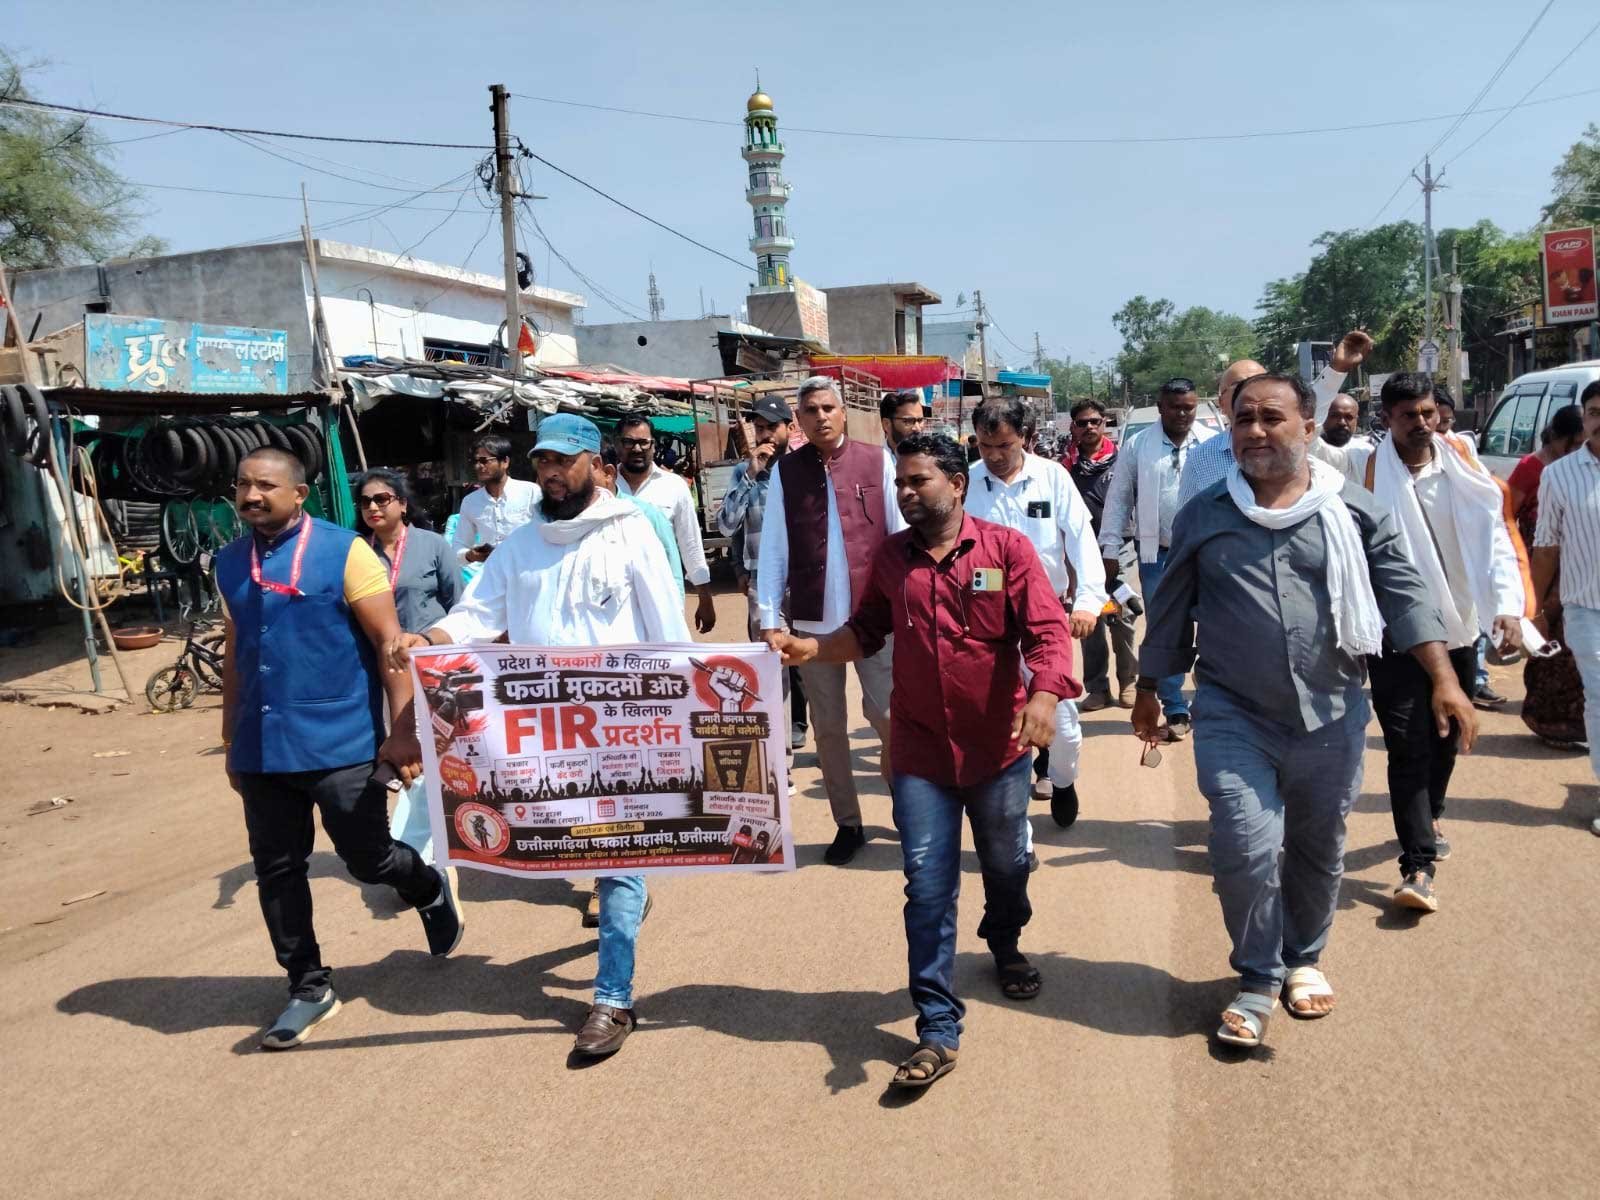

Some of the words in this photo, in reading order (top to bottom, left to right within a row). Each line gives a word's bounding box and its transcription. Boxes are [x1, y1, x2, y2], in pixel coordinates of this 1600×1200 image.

[498, 654, 531, 671] प्रदेश
[535, 653, 547, 668] में
[551, 652, 603, 668] पत्रकारों
[606, 653, 620, 669] के
[624, 653, 671, 670] खिलाफ
[504, 671, 560, 700] फर्जी
[564, 673, 643, 705] मुकदमों
[648, 675, 684, 696] और
[603, 702, 618, 717] के
[622, 702, 673, 717] खिलाफ
[698, 713, 720, 724] हमारी
[722, 715, 744, 724] कलम
[745, 715, 757, 723] पर
[504, 705, 600, 755] FIR
[602, 716, 682, 747] प्रदर्शन
[720, 724, 735, 736] नहीं
[516, 835, 589, 852] छत्तीसगढ़िया
[591, 835, 631, 849] पत्रकार
